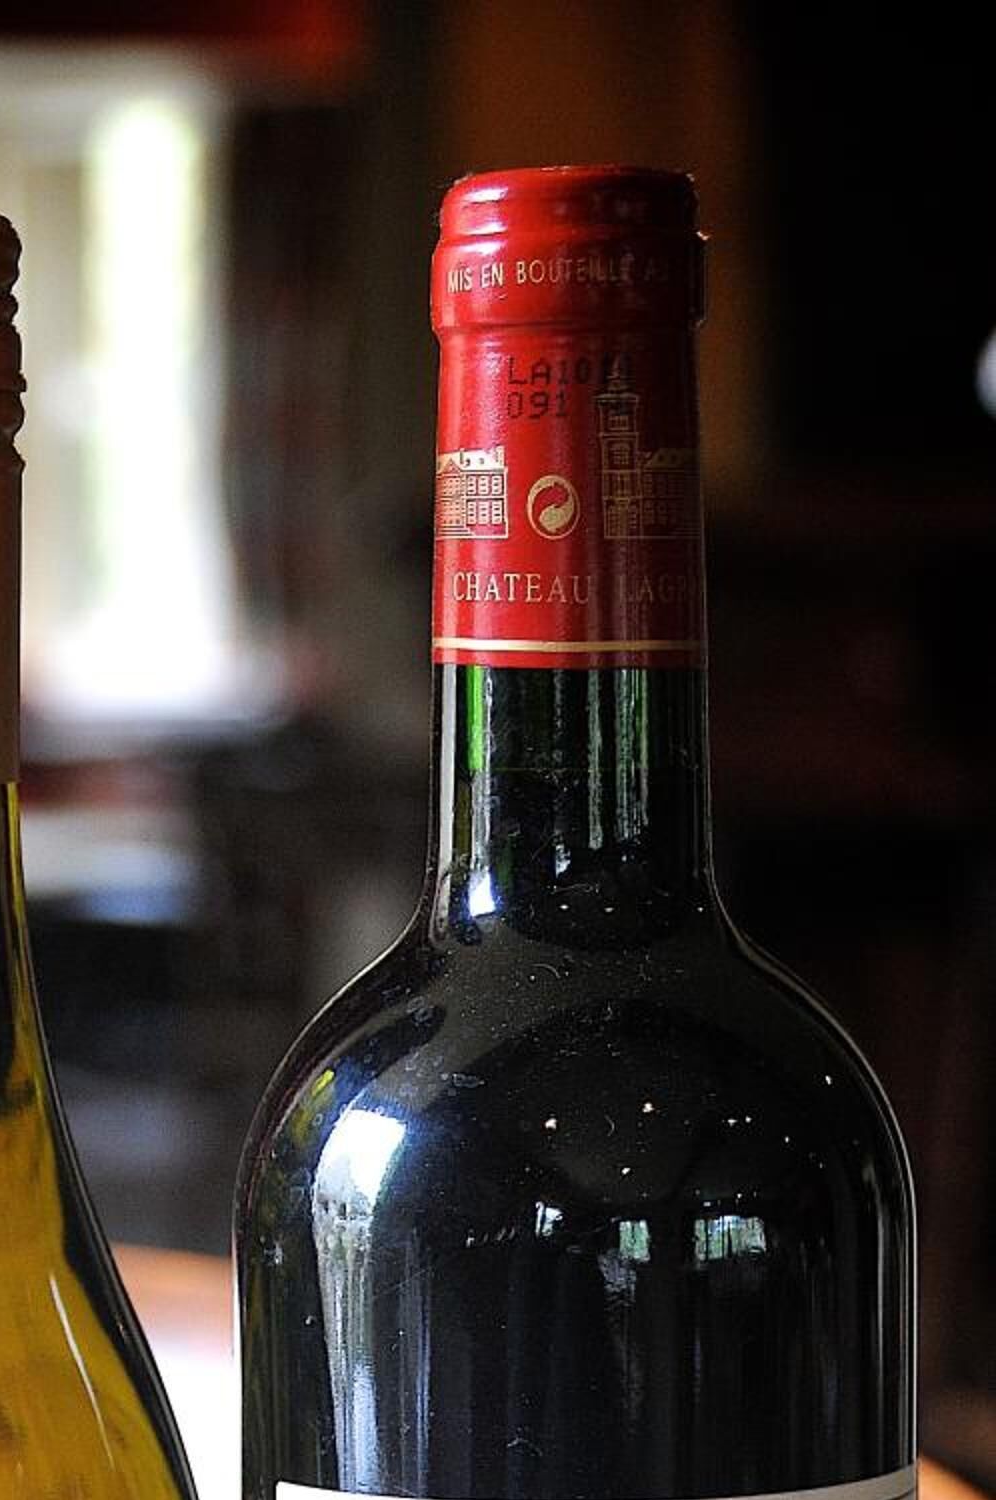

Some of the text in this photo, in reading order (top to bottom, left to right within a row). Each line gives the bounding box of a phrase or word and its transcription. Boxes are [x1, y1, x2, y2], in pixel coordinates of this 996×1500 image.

[447, 269, 473, 293] MIS
[480, 263, 504, 288] EN
[516, 254, 635, 284] BOUTEILLE
[454, 571, 592, 604] CHATEAU
